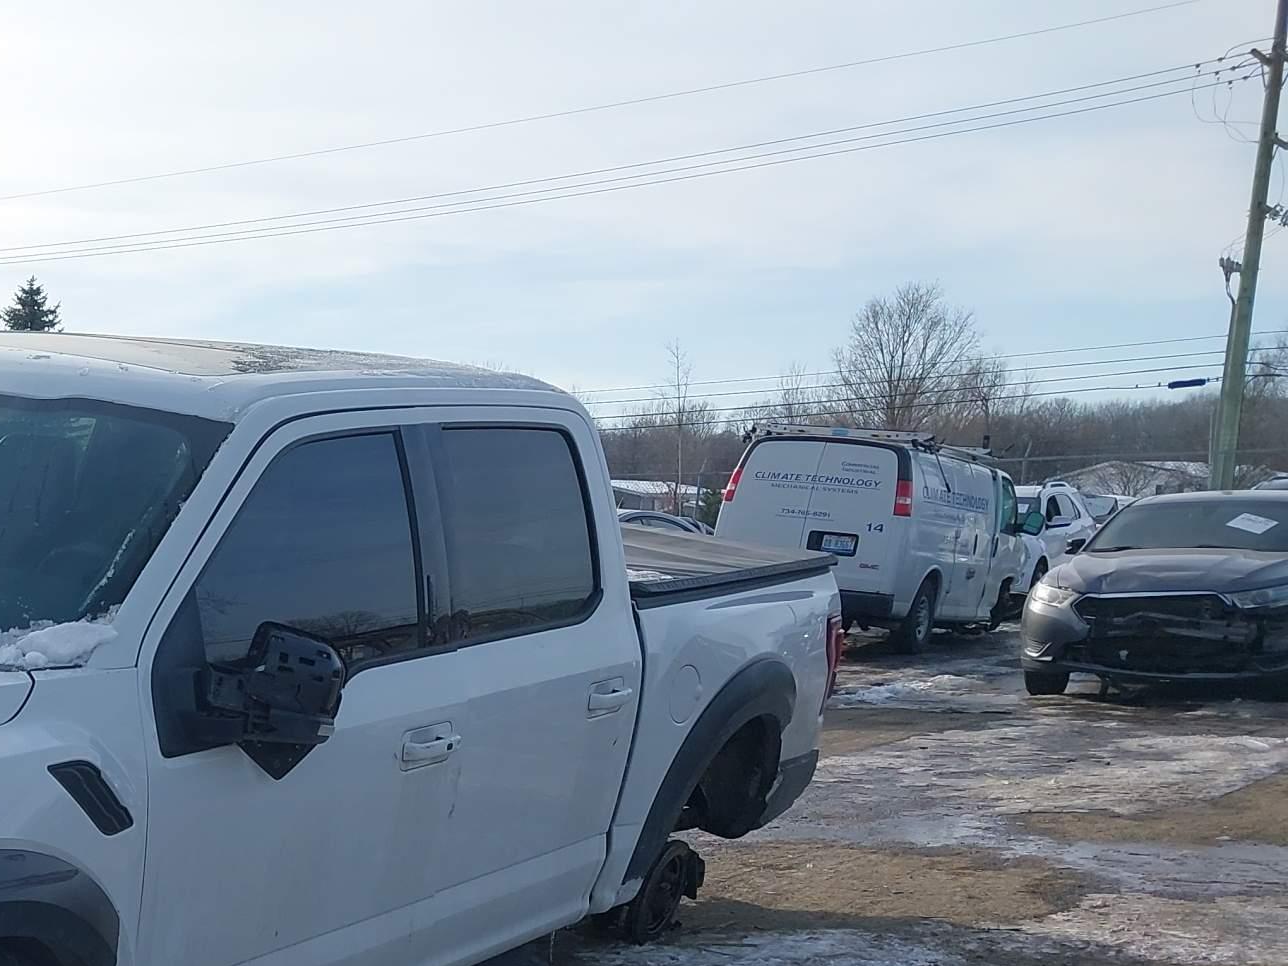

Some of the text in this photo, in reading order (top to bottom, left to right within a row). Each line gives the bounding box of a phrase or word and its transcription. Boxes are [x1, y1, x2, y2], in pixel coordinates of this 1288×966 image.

[754, 471, 882, 488] CLIMATE TECHNOLOGY
[822, 486, 859, 495] SYSTEMS
[866, 522, 884, 533] 14
